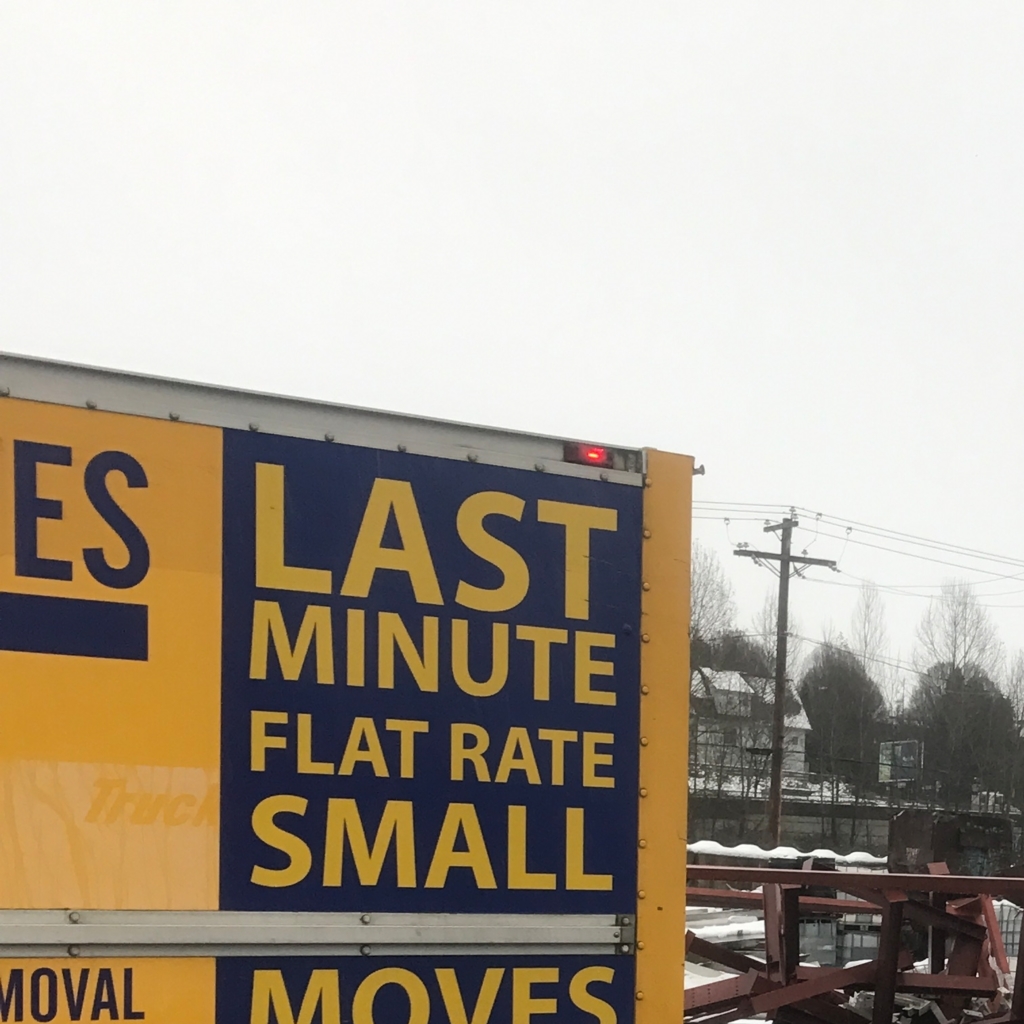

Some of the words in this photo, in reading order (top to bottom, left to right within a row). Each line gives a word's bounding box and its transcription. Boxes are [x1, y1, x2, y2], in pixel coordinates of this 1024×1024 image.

[13, 439, 151, 589] ES
[255, 462, 618, 621] LAST
[249, 599, 617, 706] MINUTE
[250, 709, 430, 779] FLAT
[450, 722, 615, 789] RATE
[250, 793, 614, 891] SMALL
